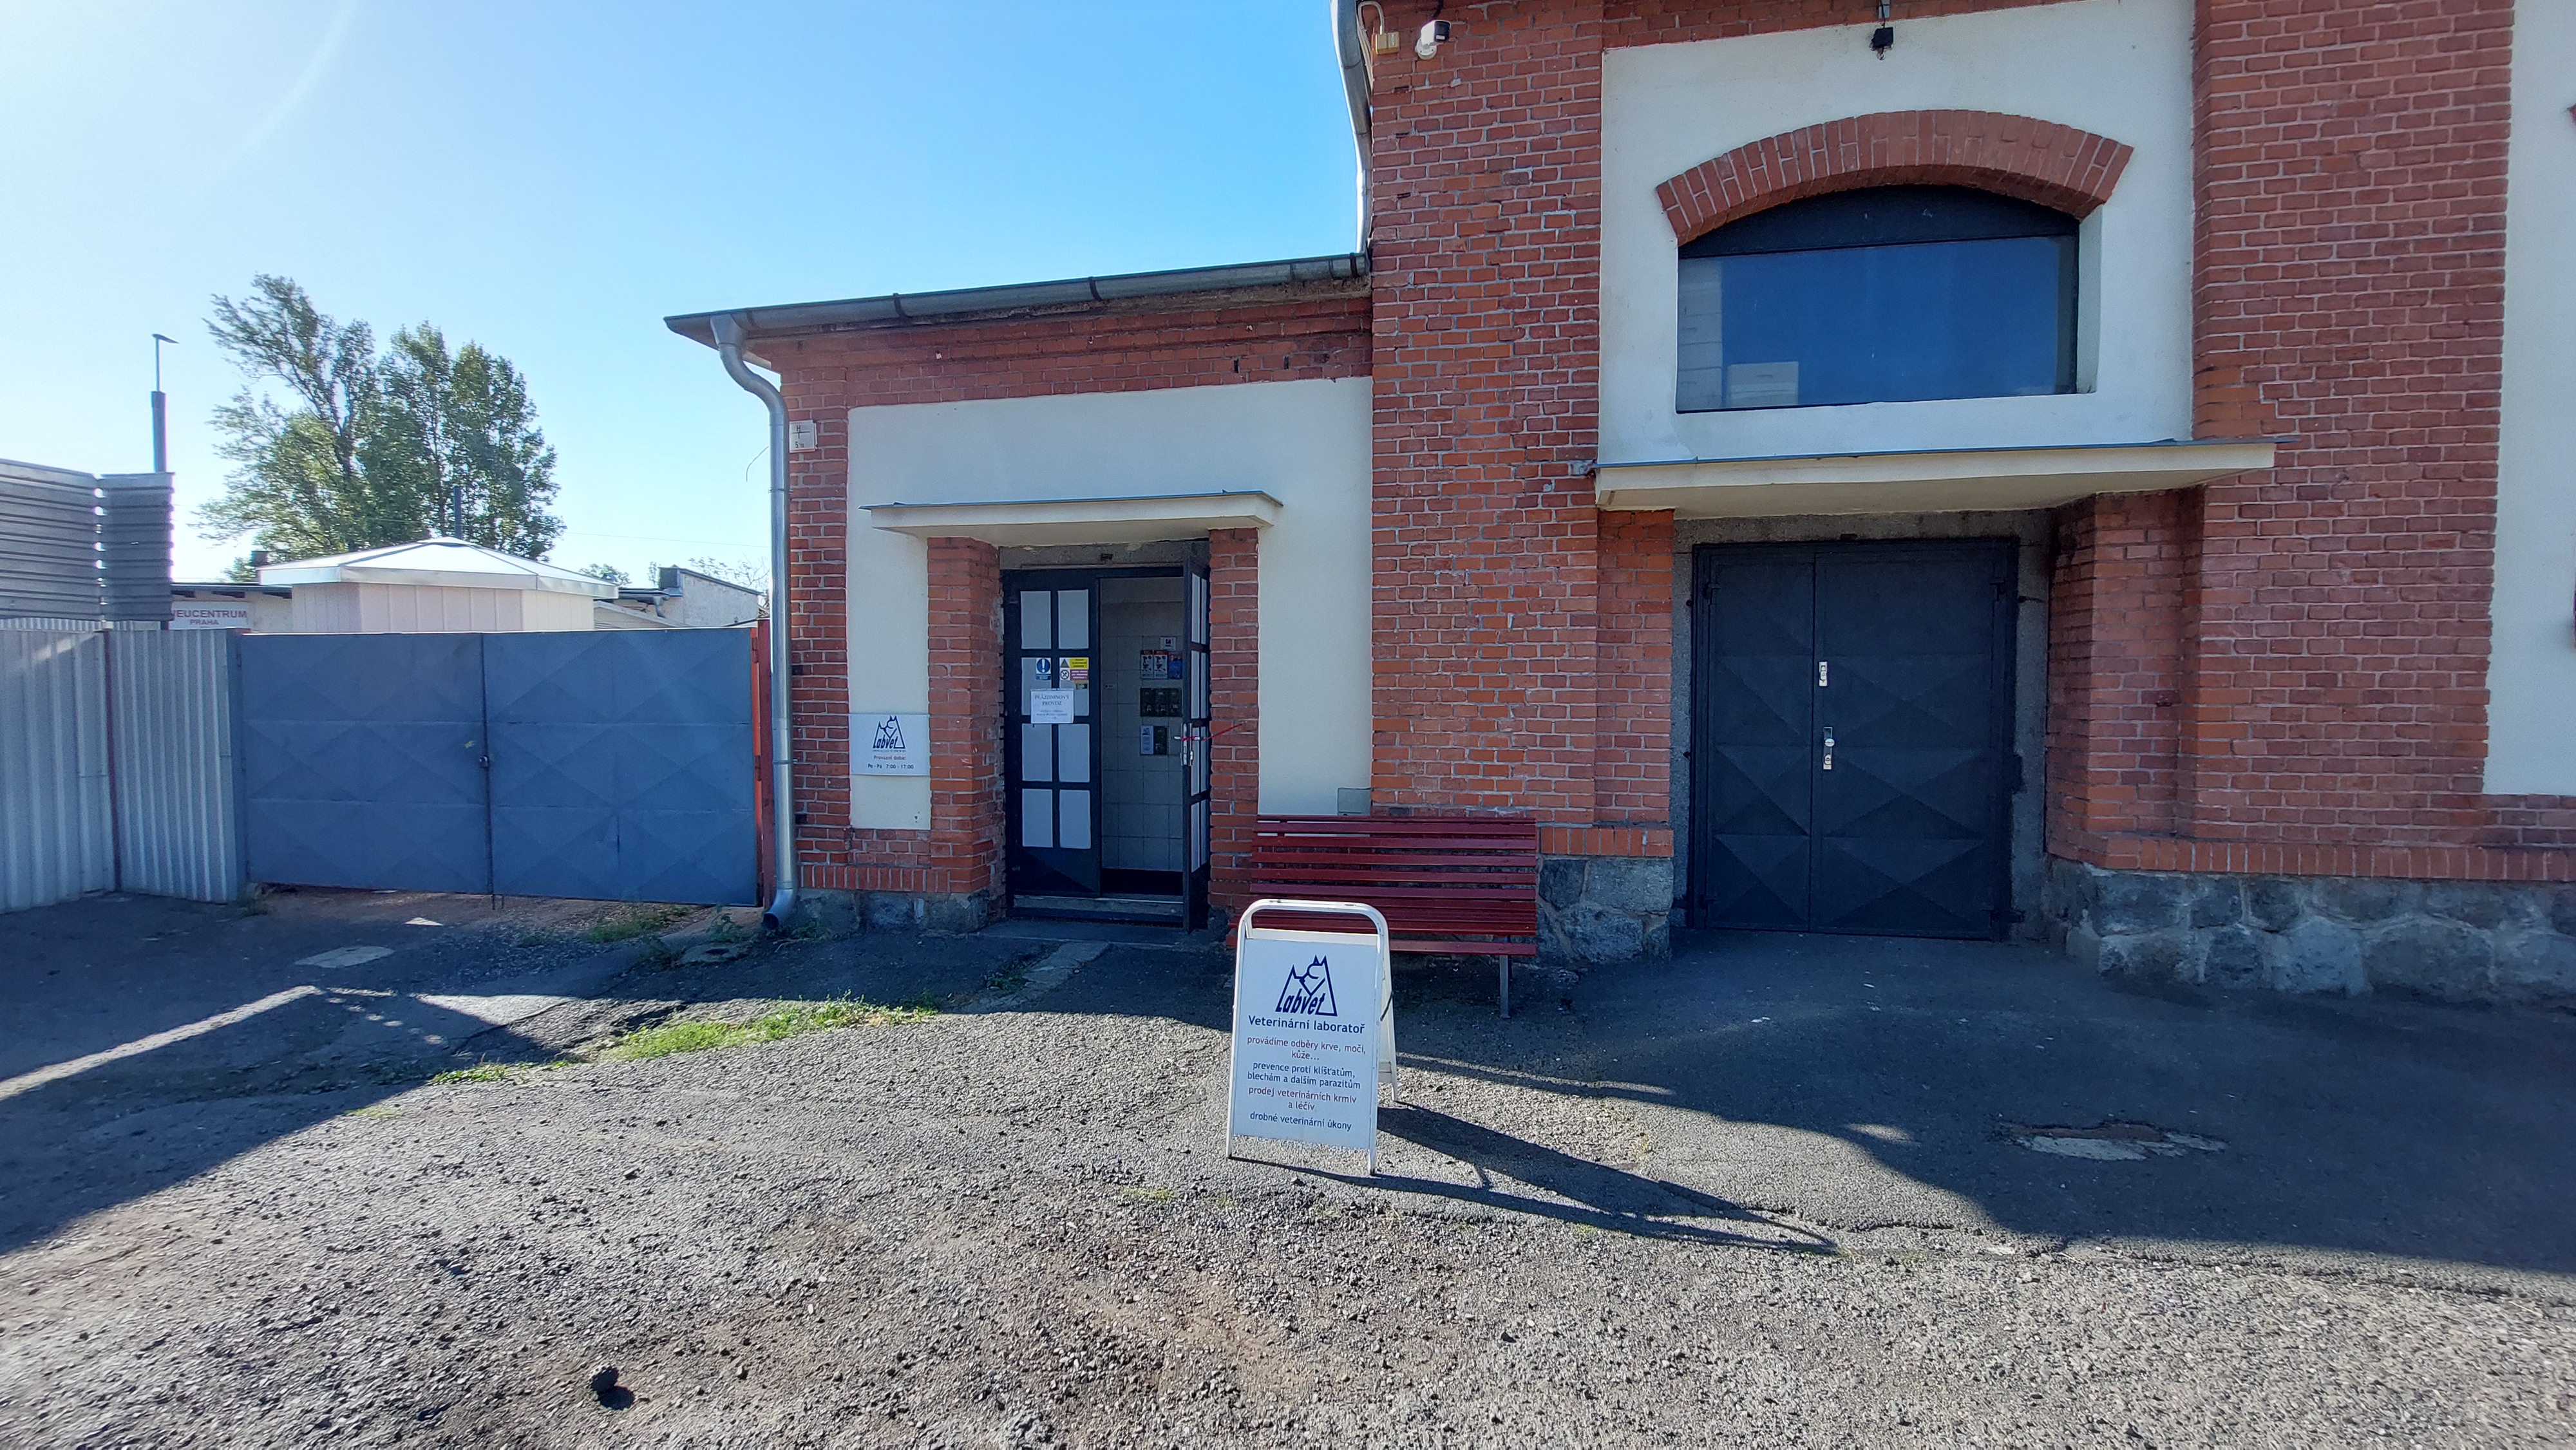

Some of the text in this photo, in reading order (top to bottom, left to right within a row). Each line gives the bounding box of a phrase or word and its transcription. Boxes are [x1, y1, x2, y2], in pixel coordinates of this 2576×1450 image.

[873, 735, 898, 749] Labvet
[1275, 988, 1326, 1015] Labvet
[1248, 1015, 1365, 1034] Veterinární laboratoř
[1247, 1036, 1366, 1055] provádíme odběry krve, moči,
[1253, 1062, 1356, 1078] prevence proti klíšťatům,
[1247, 1071, 1281, 1082] blechám
[1291, 1075, 1316, 1086] dalším
[1319, 1078, 1361, 1089] parazitům
[1249, 1086, 1357, 1104] prodej veterinárních krmiv
[1296, 1101, 1315, 1111] léčiv
[1250, 1111, 1352, 1132] drobné veterinární úkony
